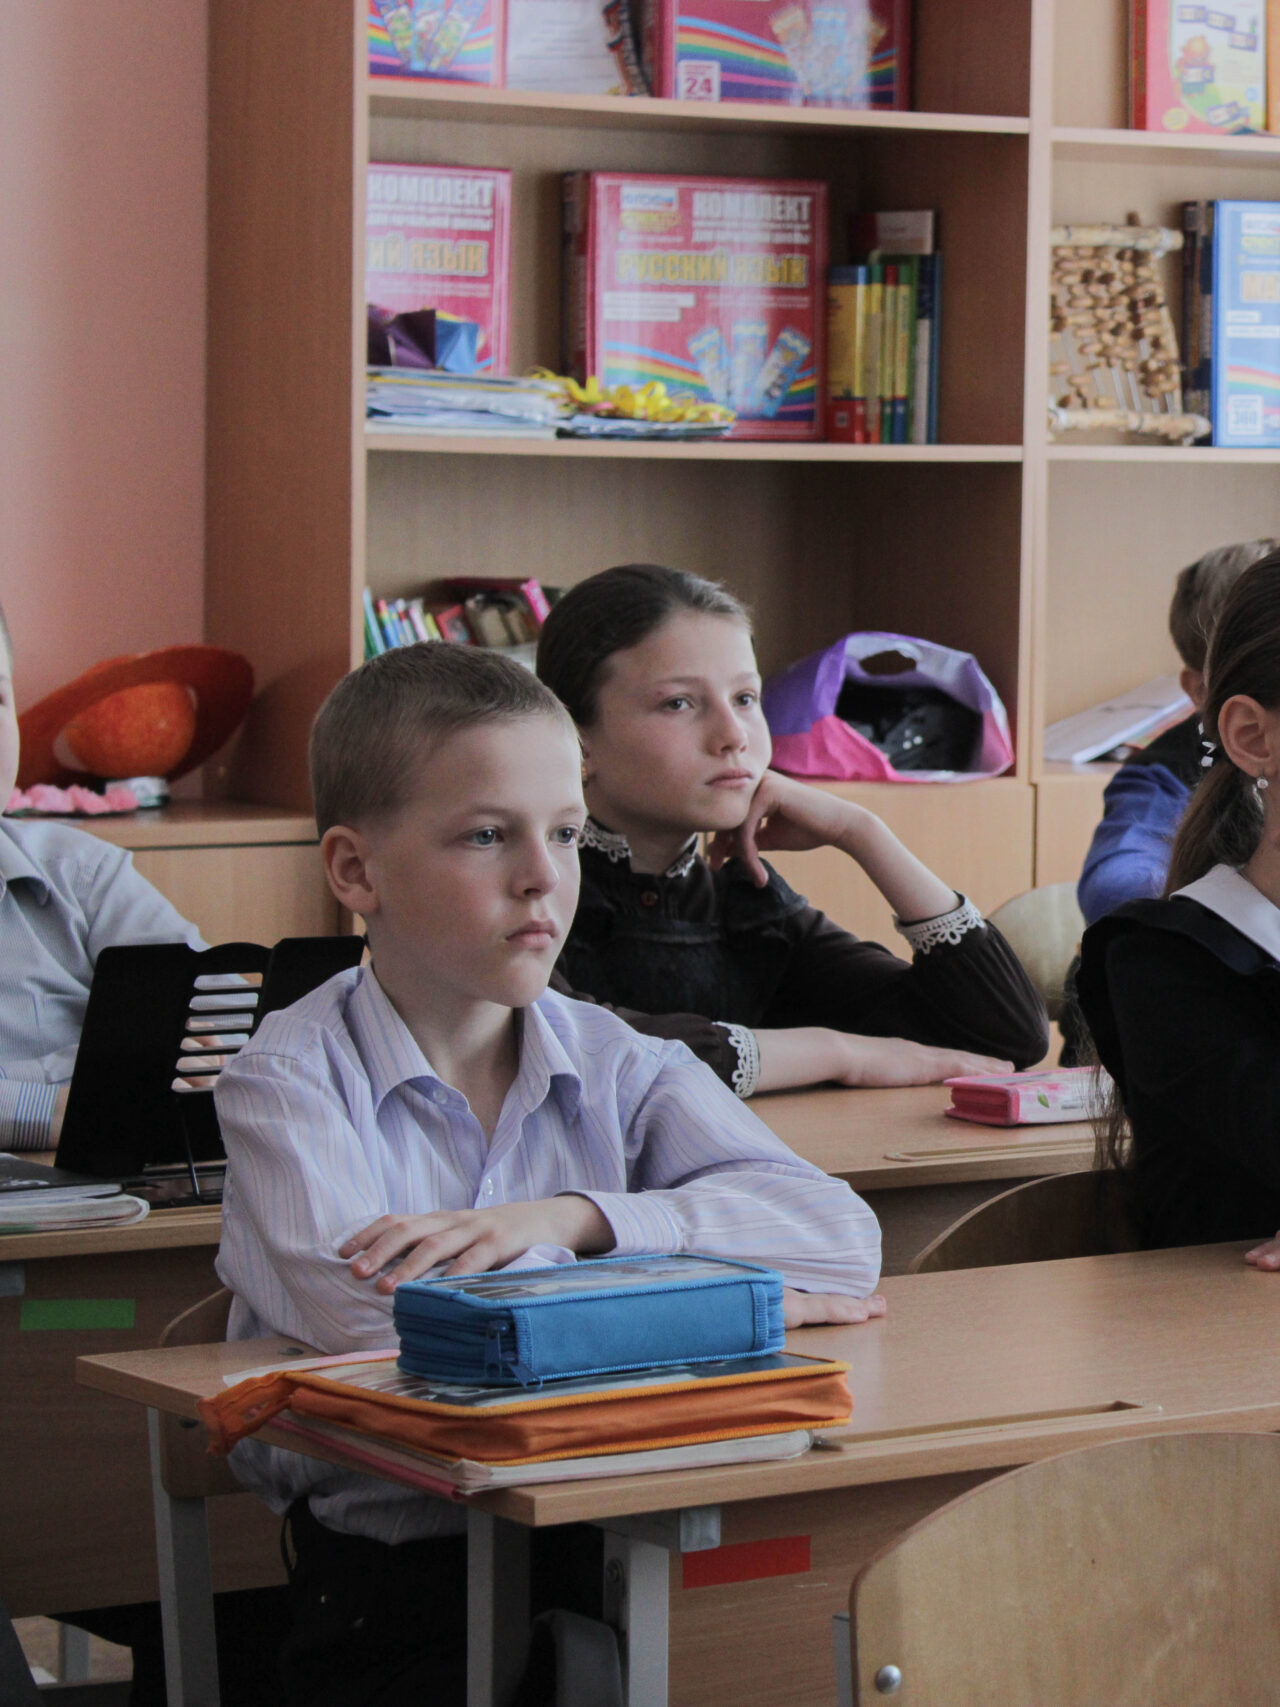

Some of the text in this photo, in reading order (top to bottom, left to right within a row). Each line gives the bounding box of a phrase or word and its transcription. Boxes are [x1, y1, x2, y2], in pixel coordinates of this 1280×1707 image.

[686, 77, 713, 94] 24
[408, 240, 486, 274] ЯЗЫК
[618, 248, 808, 285] РУССКИЙ ЯЗЫК
